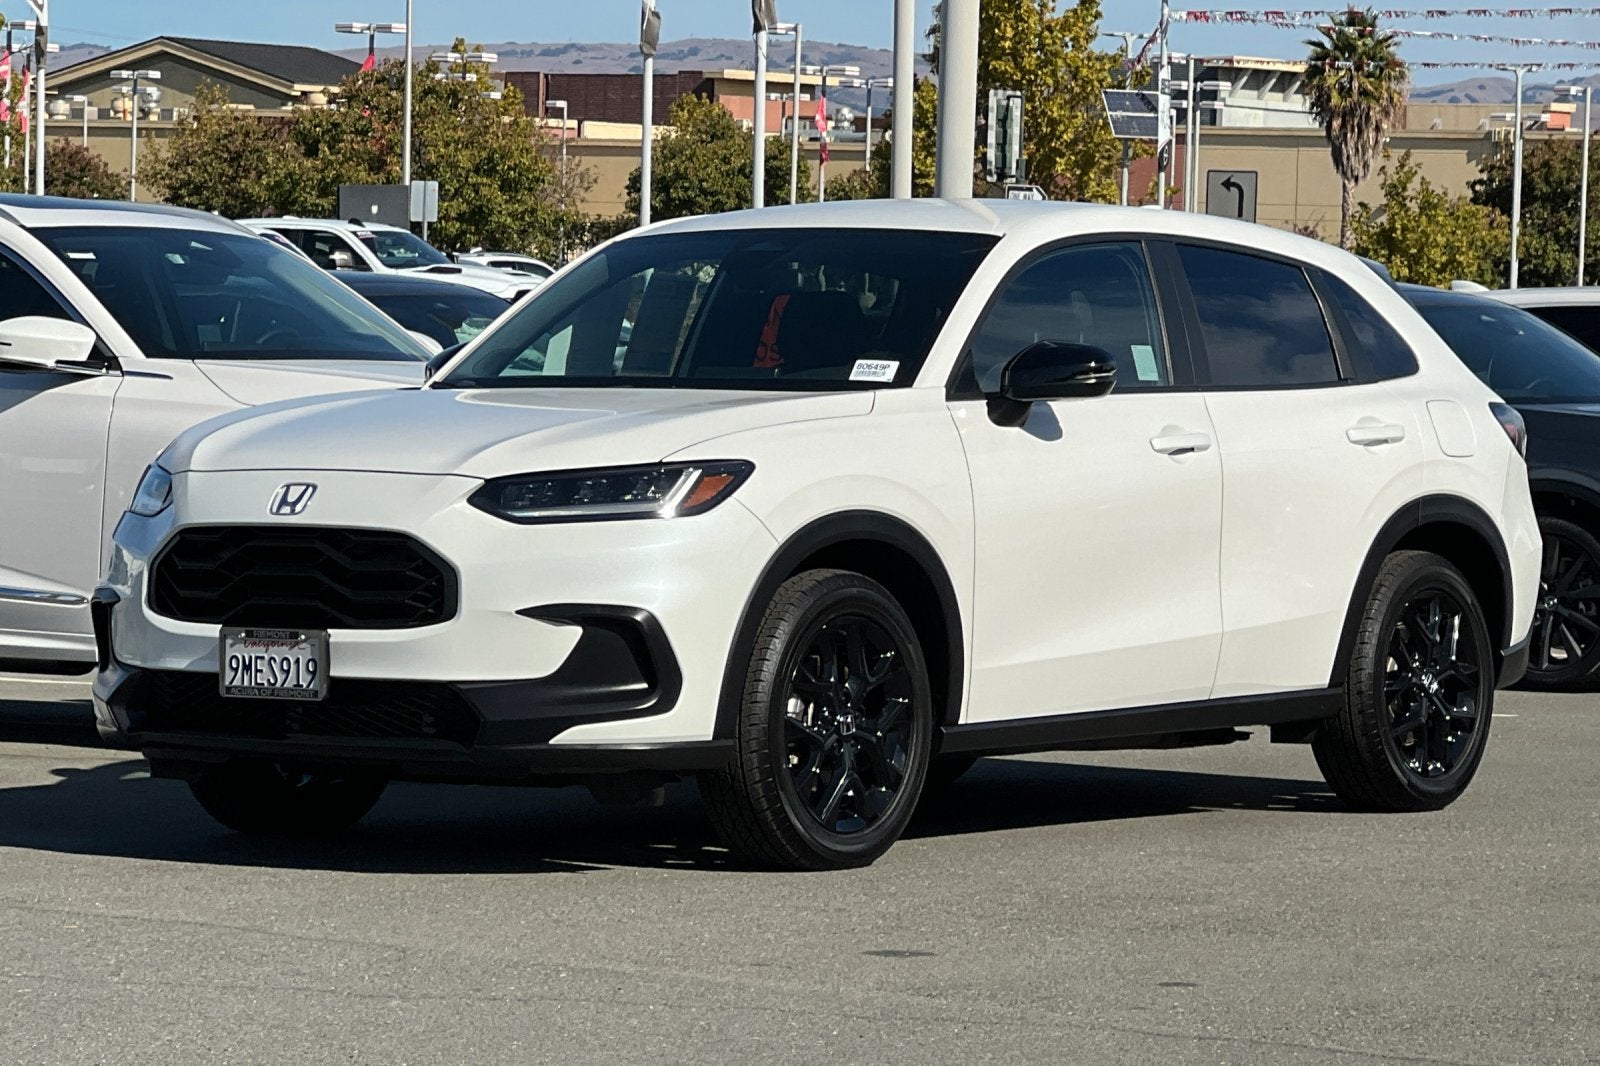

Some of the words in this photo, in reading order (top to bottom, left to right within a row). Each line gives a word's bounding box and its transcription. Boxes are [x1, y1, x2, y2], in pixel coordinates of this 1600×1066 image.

[253, 631, 290, 639] FREMONT
[229, 655, 318, 688] 9MES919
[230, 687, 259, 696] ACURA
[260, 688, 273, 696] OF
[274, 689, 315, 698] FREMONT
